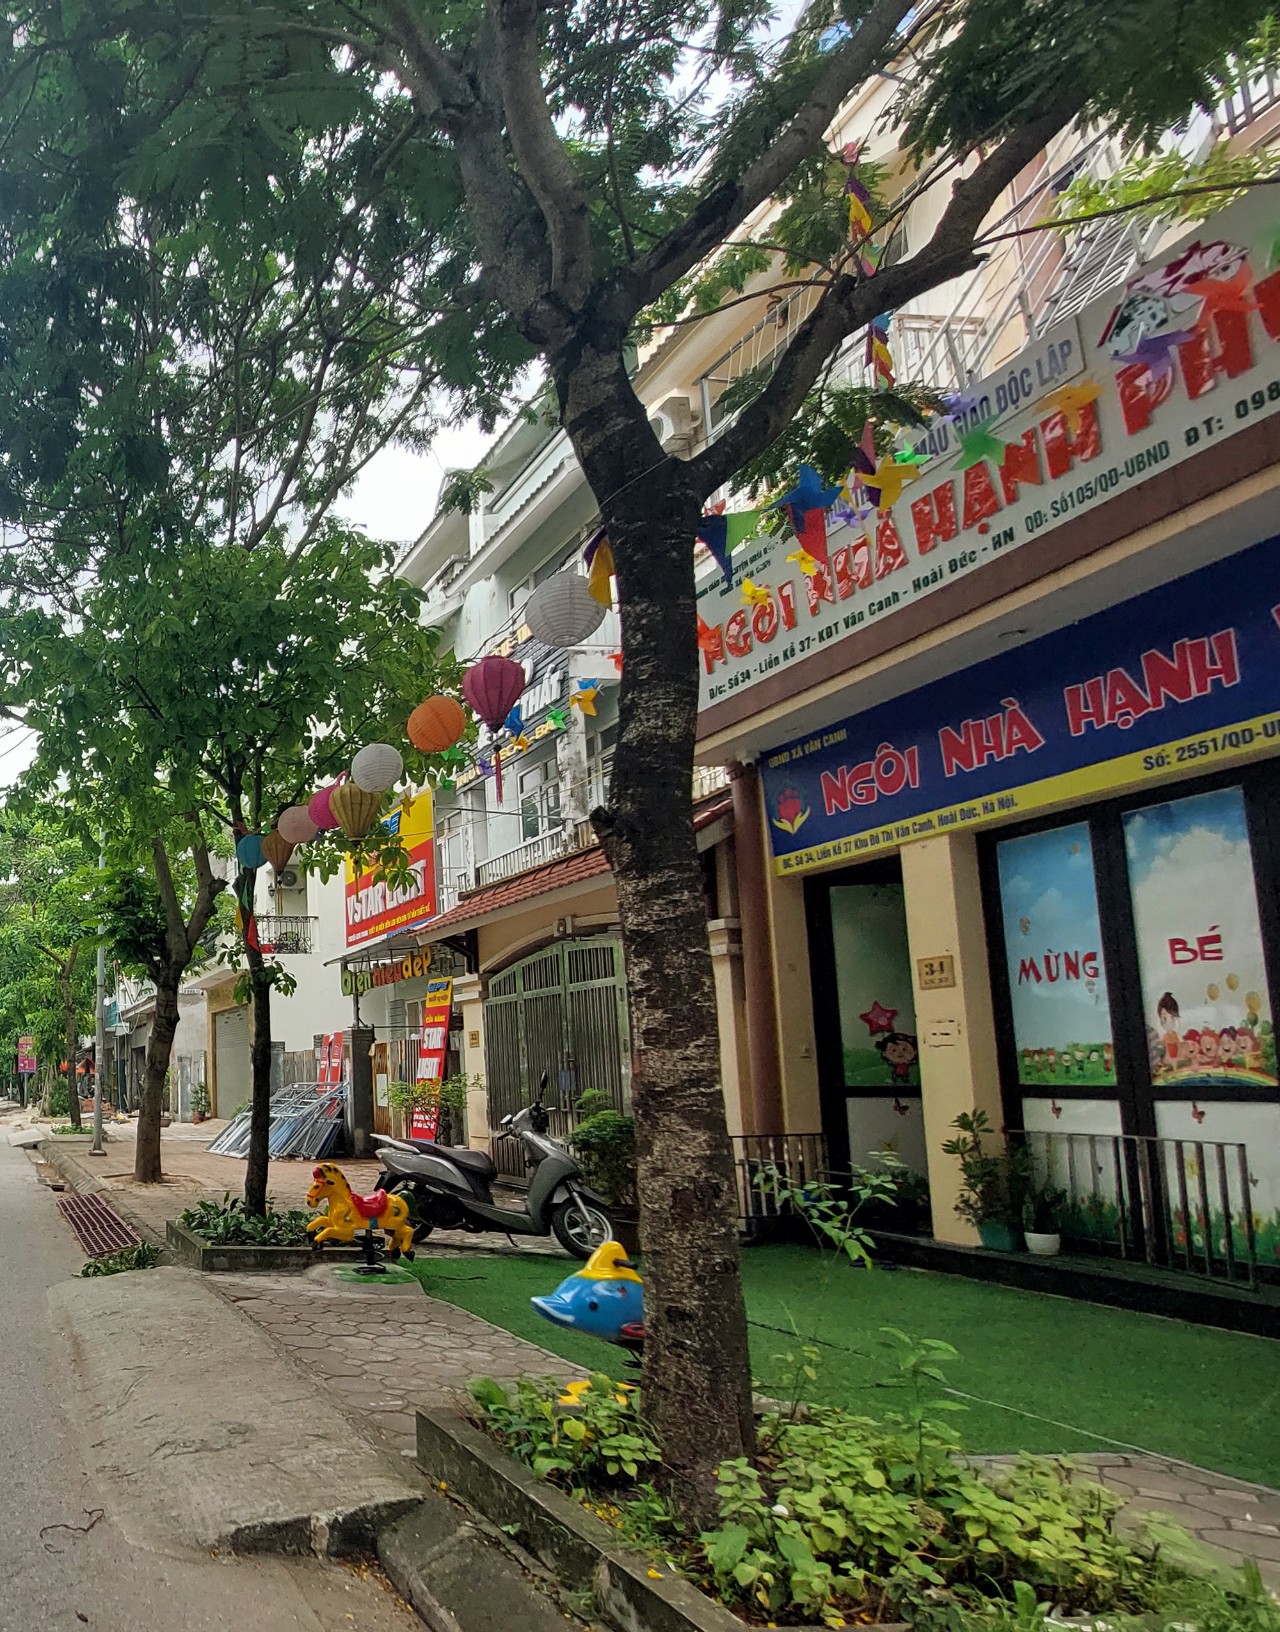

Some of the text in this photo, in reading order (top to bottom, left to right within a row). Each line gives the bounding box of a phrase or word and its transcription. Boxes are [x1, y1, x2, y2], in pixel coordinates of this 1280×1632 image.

[995, 368, 1032, 415] ĐỘC
[1035, 338, 1072, 389] LẬP
[782, 640, 796, 662] Kề
[842, 609, 864, 630] Vân
[867, 590, 900, 616] Canh
[911, 564, 943, 594] Hoài
[948, 547, 977, 575] Đức
[991, 526, 1015, 551] HN
[820, 627, 1241, 816] NGÔI NHÀ HẠNH
[1142, 747, 1171, 771] Số:
[843, 841, 852, 853] 37
[937, 810, 957, 827] Hoài
[982, 800, 995, 815] Hà
[1018, 948, 1099, 985] MỪNG
[1168, 925, 1224, 965] BÉ
[423, 1027, 445, 1050] STAR
